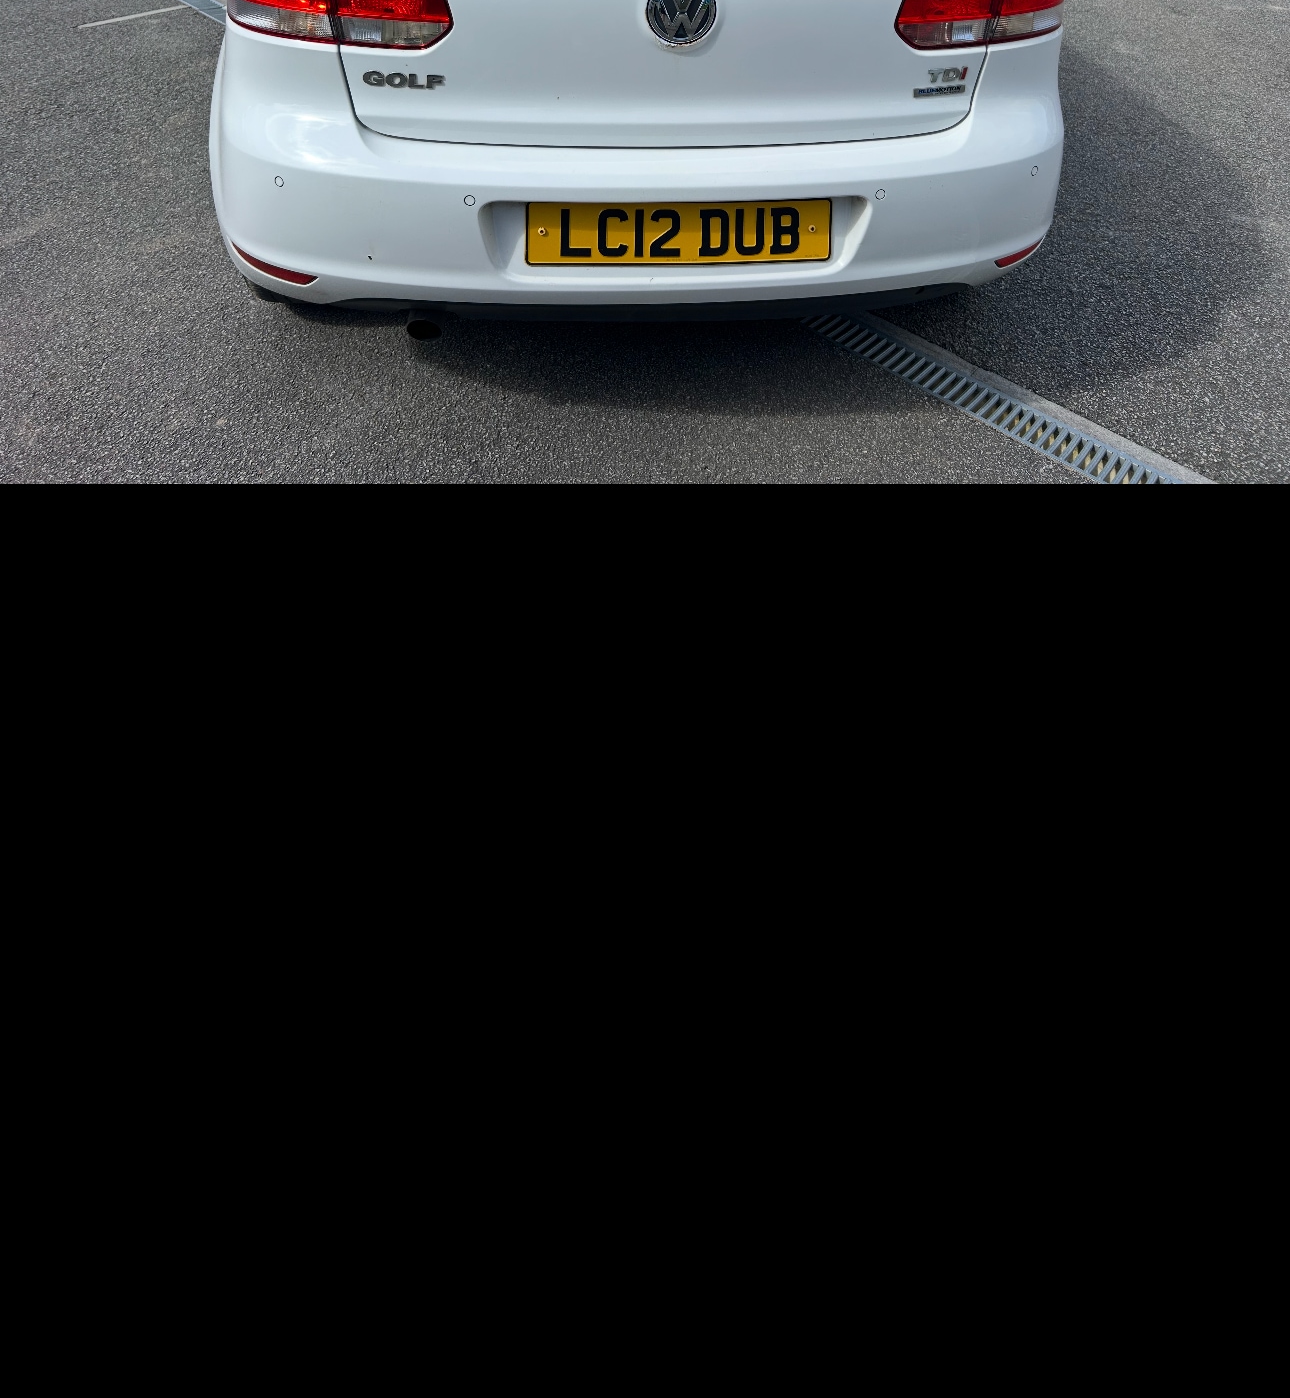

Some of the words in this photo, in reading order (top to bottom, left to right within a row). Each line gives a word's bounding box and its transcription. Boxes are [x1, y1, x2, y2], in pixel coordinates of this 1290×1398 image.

[362, 70, 446, 90] GOLF
[928, 66, 968, 84] TDI
[560, 208, 681, 258] LC12
[698, 206, 800, 257] DUB
